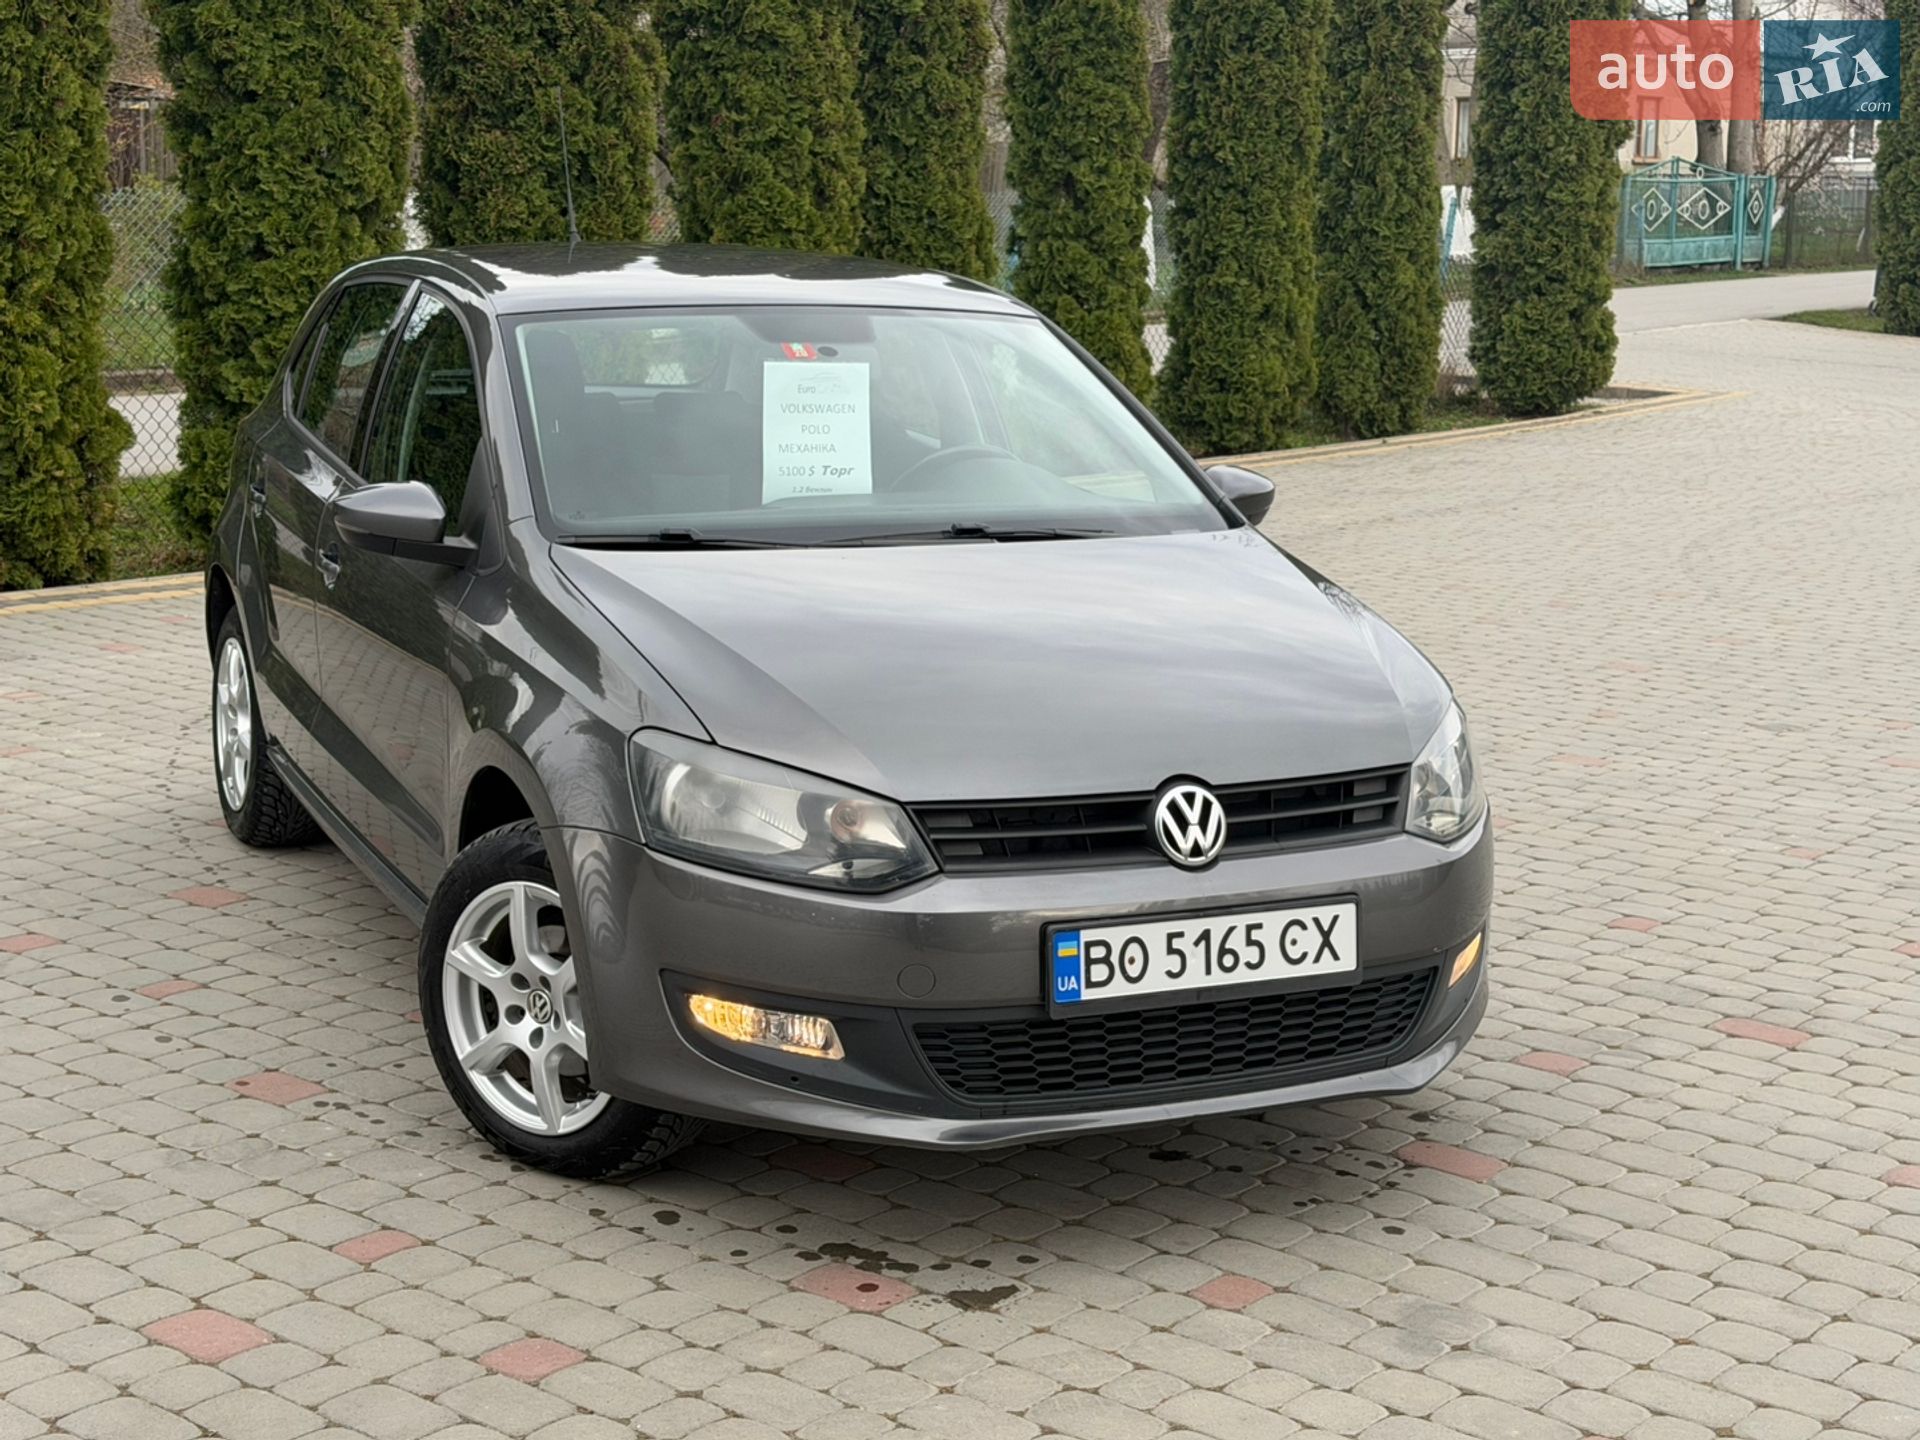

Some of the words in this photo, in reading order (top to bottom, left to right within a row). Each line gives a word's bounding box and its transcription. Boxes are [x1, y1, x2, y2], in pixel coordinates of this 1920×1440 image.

[797, 384, 816, 394] Euro
[780, 403, 856, 414] VOLKSWAGEN
[801, 424, 831, 435] POLO
[778, 443, 837, 454] МЕХАНІКА
[778, 466, 806, 477] 5100
[1084, 936, 1149, 989] BO
[1164, 922, 1266, 979] 5165
[1279, 914, 1341, 965] CX
[1058, 975, 1078, 991] UA
